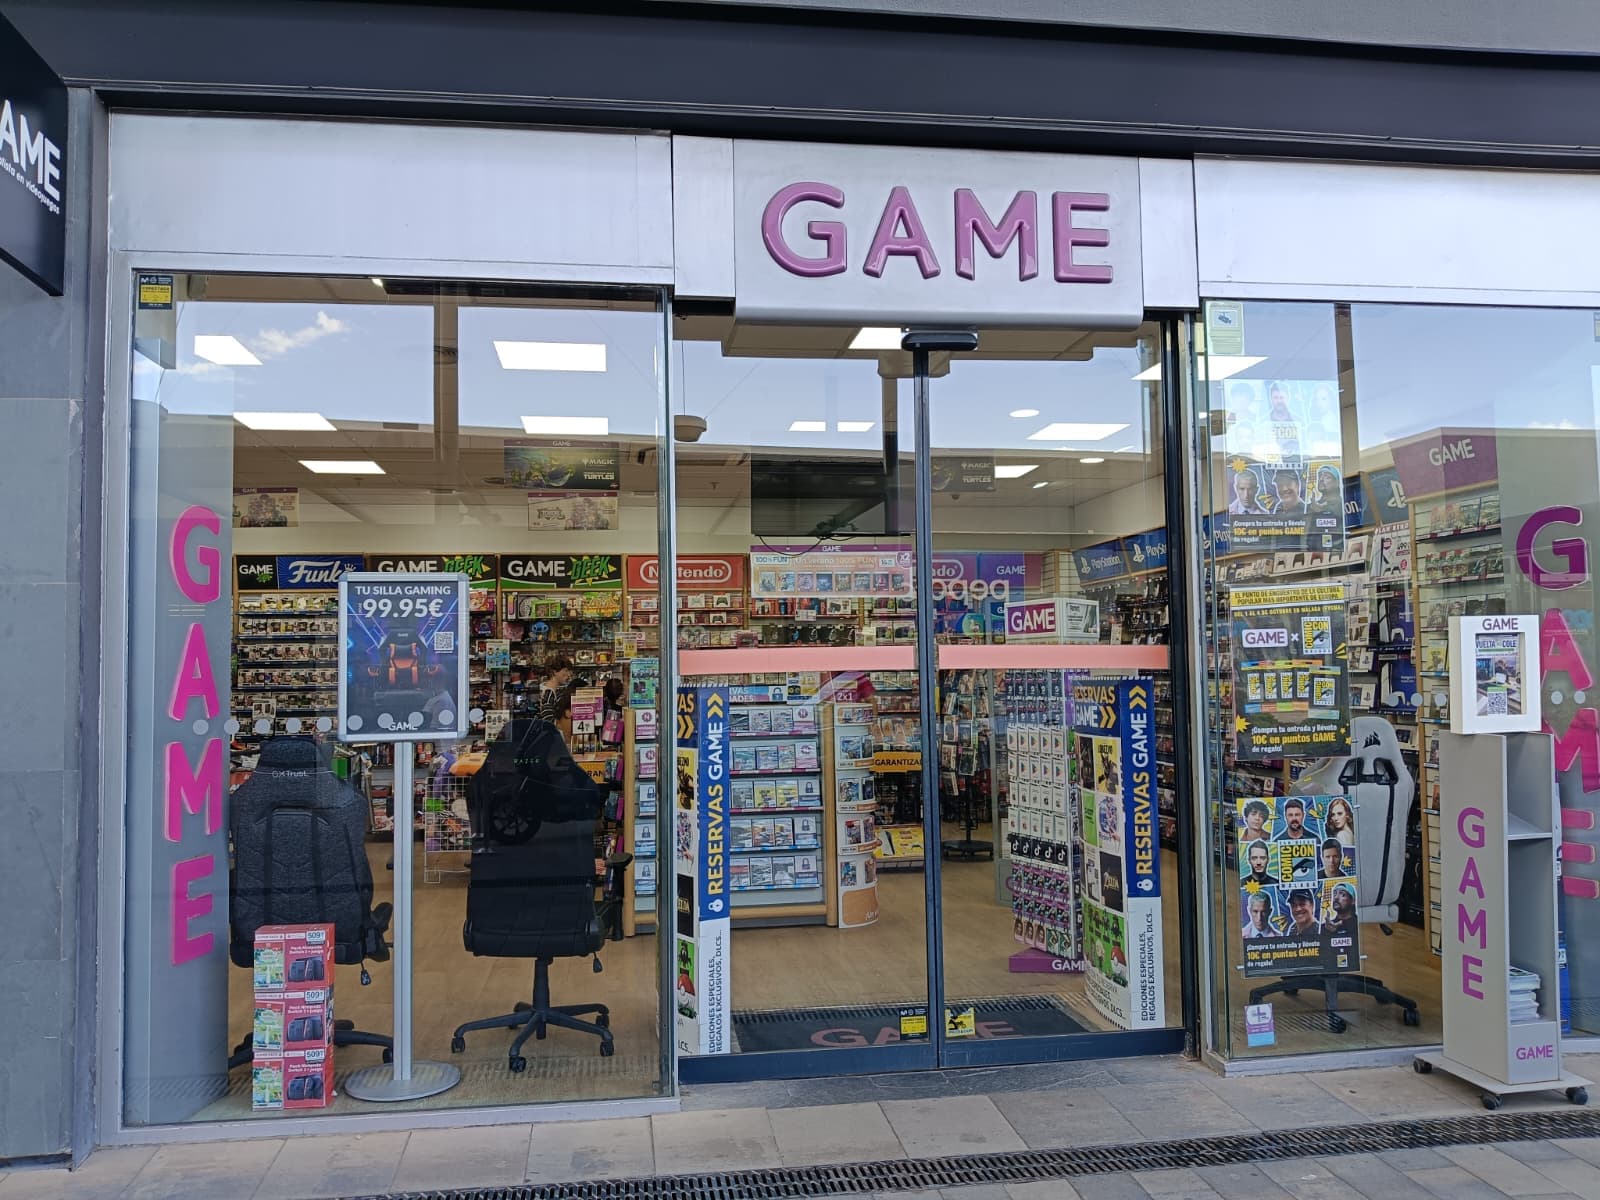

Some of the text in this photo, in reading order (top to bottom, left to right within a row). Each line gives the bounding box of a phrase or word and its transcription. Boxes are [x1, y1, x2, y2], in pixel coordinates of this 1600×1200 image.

[0, 99, 60, 201] AME
[16, 171, 25, 184] en
[25, 180, 60, 214] videojuegos
[761, 181, 1113, 284] GAME
[1429, 438, 1475, 466] GAME
[1285, 527, 1305, 535] GAME
[239, 564, 273, 575] GAME
[288, 560, 341, 583] Funk
[378, 560, 438, 573] GAME
[507, 555, 612, 580] GAME GEEK
[997, 565, 1026, 575] GAME
[355, 586, 451, 595] TU SILLA GAMING
[363, 598, 444, 618] 99.95€
[1011, 607, 1055, 632] GAME
[1304, 621, 1314, 649] COMIC
[1312, 620, 1329, 630] CON
[1482, 617, 1519, 631] GAME
[1245, 631, 1285, 645] GAME
[164, 504, 223, 967] GAME
[1270, 736, 1281, 744] en
[1282, 734, 1311, 744] puntos
[1313, 732, 1337, 742] GAME
[1287, 724, 1311, 732] entrada
[1130, 712, 1153, 875] RESERVAS GAME
[707, 721, 724, 895] RESERVAS GAME
[1292, 845, 1314, 857] CON
[1280, 846, 1293, 882] COMIC
[1457, 806, 1487, 1001] GAME
[1273, 950, 1297, 960] puntos
[1299, 948, 1320, 957] GAME
[1140, 979, 1148, 1021] EDICIONES
[1148, 985, 1156, 1021] REGALOS
[715, 1013, 723, 1052] REGALOS
[811, 1020, 1023, 1048] GAE
[1516, 1044, 1554, 1061] GAME
